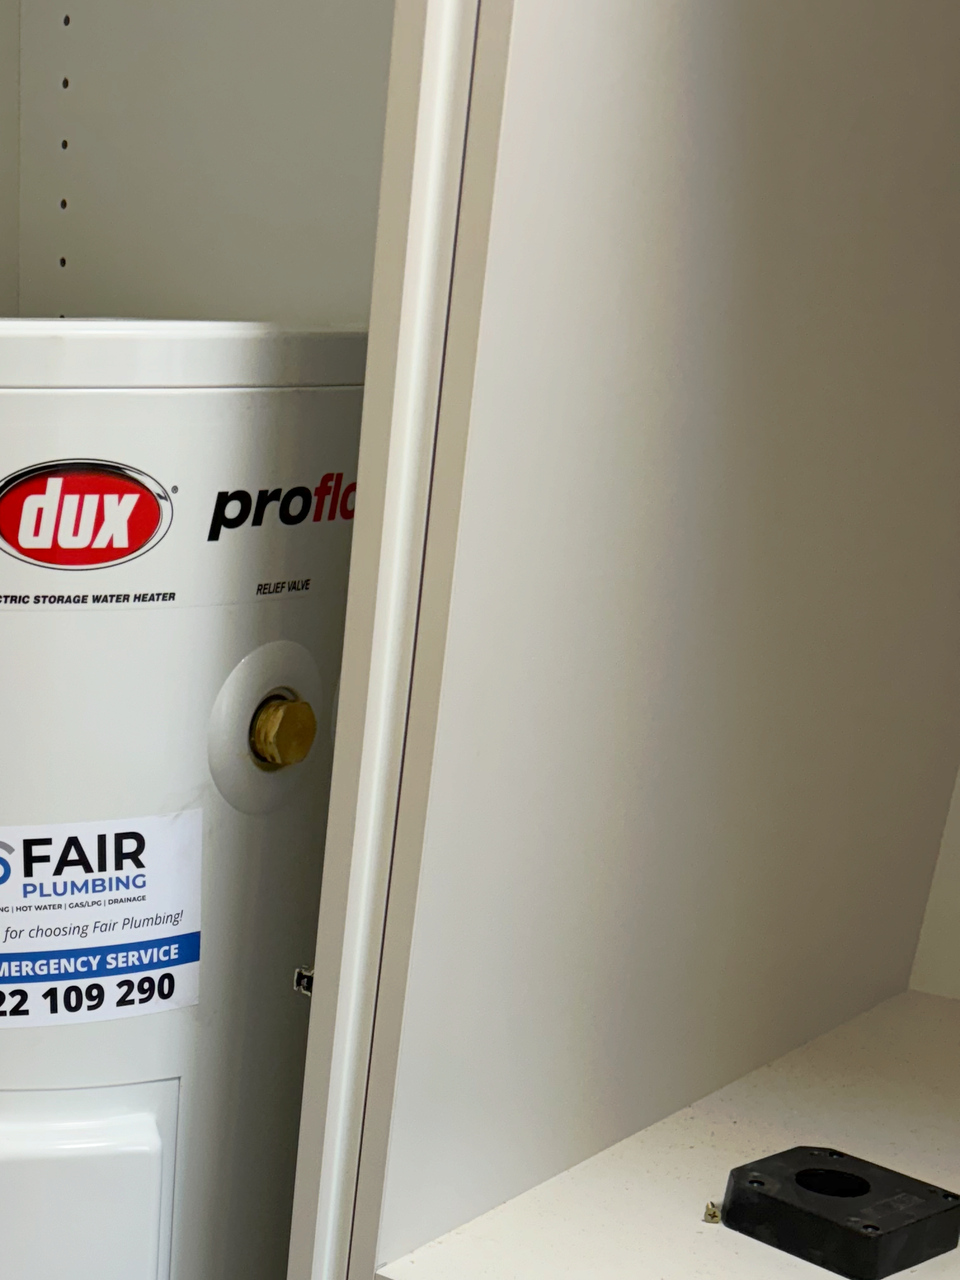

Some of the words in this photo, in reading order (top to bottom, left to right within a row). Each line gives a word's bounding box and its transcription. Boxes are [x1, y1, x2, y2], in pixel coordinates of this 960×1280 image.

[18, 477, 140, 550] dux
[34, 595, 89, 605] STORAGE
[92, 594, 131, 604] WATER
[134, 593, 176, 602] HEATER
[256, 582, 285, 596] RELIEF
[287, 579, 311, 592] VALVE
[23, 832, 146, 878] FAIR
[23, 874, 147, 898] PLUMBING
[35, 903, 62, 911] WATER
[68, 900, 102, 909] GAS/LPG
[108, 895, 146, 905] DRAINAGE
[4, 926, 24, 943] for
[29, 923, 89, 938] choosing
[93, 919, 118, 934] Fair
[122, 910, 184, 930] Plumbing!
[106, 944, 179, 968] SERVICE
[42, 983, 105, 1014] 109
[116, 973, 175, 1007] 290
